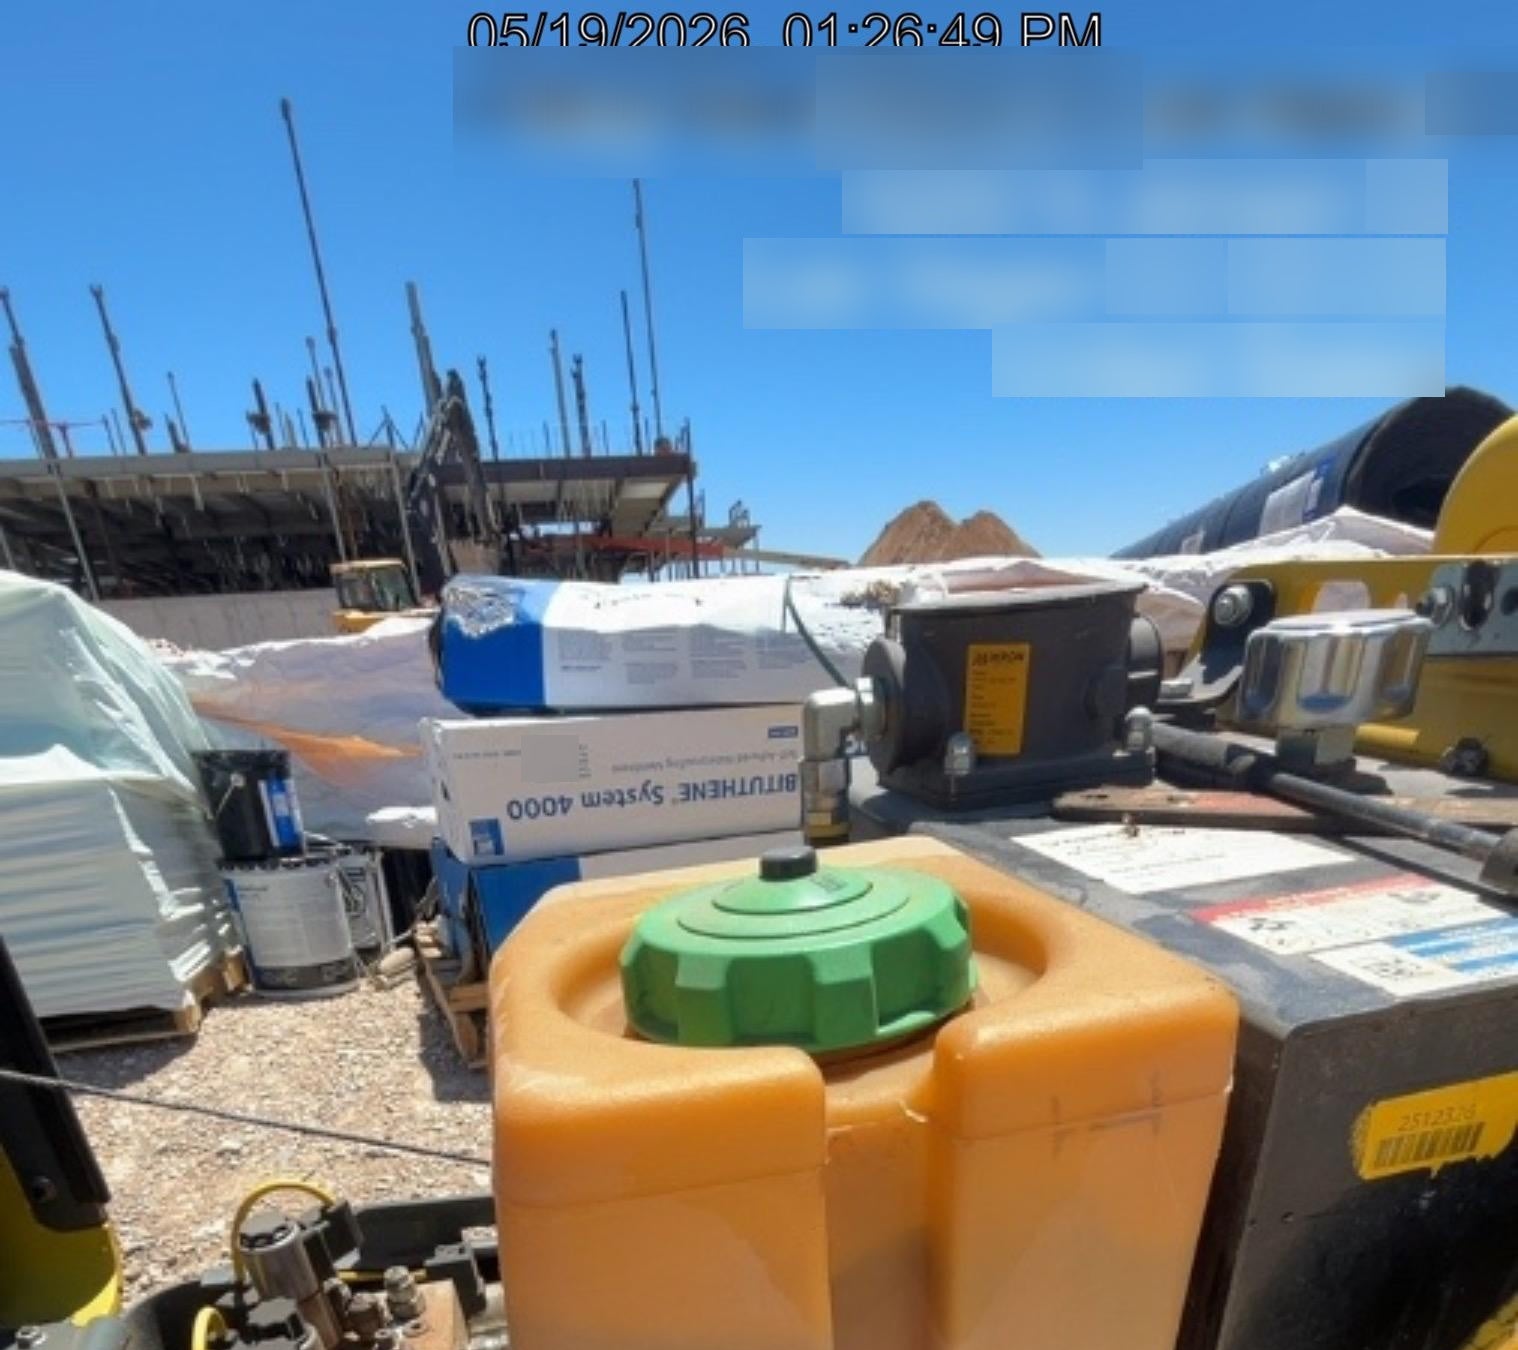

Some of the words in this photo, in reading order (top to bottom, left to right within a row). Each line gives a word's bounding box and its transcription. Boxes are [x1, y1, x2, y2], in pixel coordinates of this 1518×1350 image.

[581, 779, 664, 808] System
[679, 772, 798, 803] BITUTHENE
[506, 797, 573, 821] 4000
